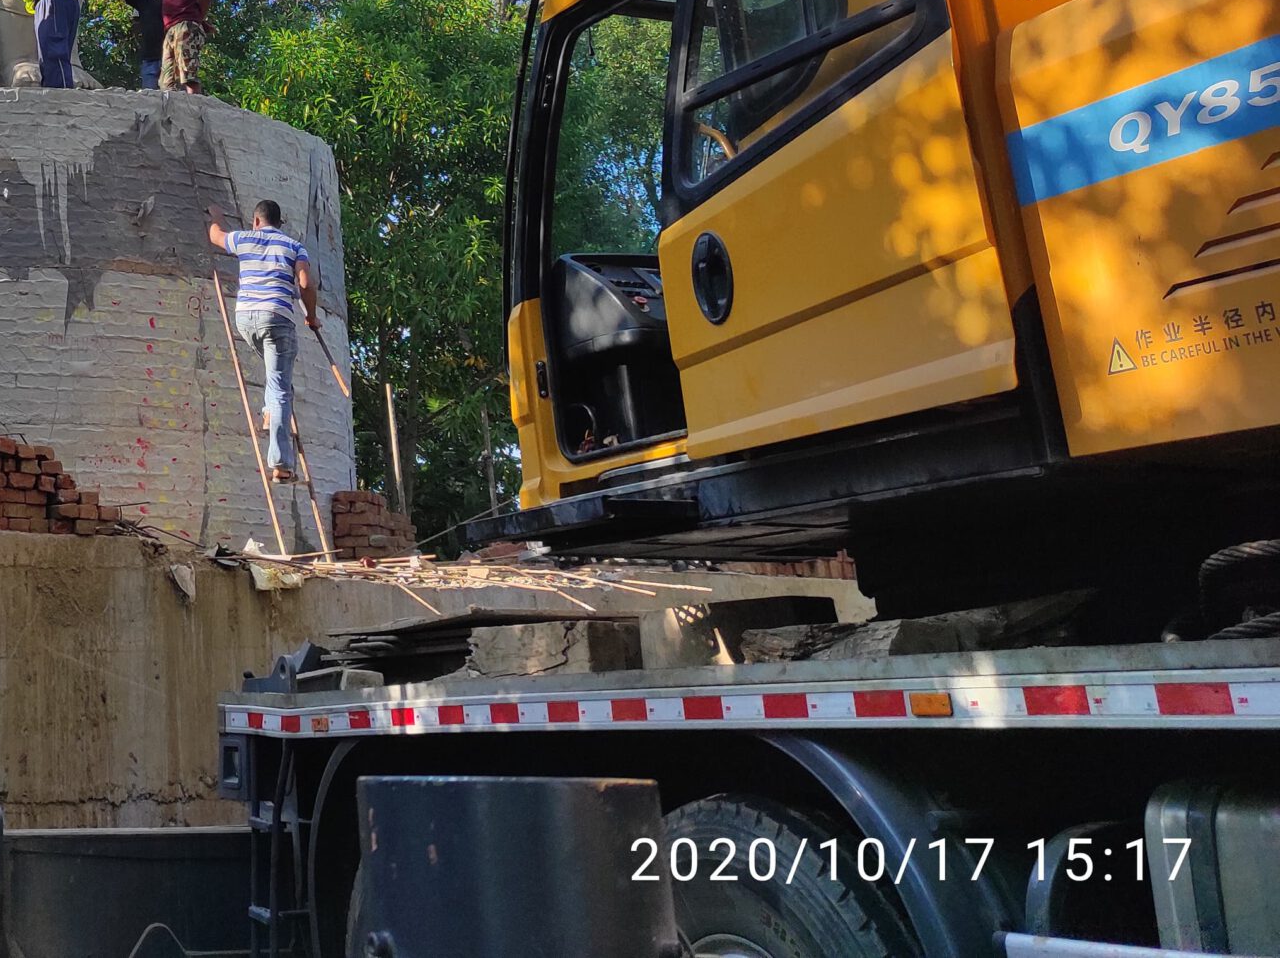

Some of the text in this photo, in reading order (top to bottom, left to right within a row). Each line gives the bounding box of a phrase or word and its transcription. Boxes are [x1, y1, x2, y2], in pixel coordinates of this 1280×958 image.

[1109, 62, 1280, 153] QY85
[1135, 301, 1276, 350] 作业半径内
[1141, 354, 1157, 367] BE
[1161, 340, 1220, 363] CAREFUL
[1223, 335, 1240, 350] IN
[1243, 329, 1273, 346] THE
